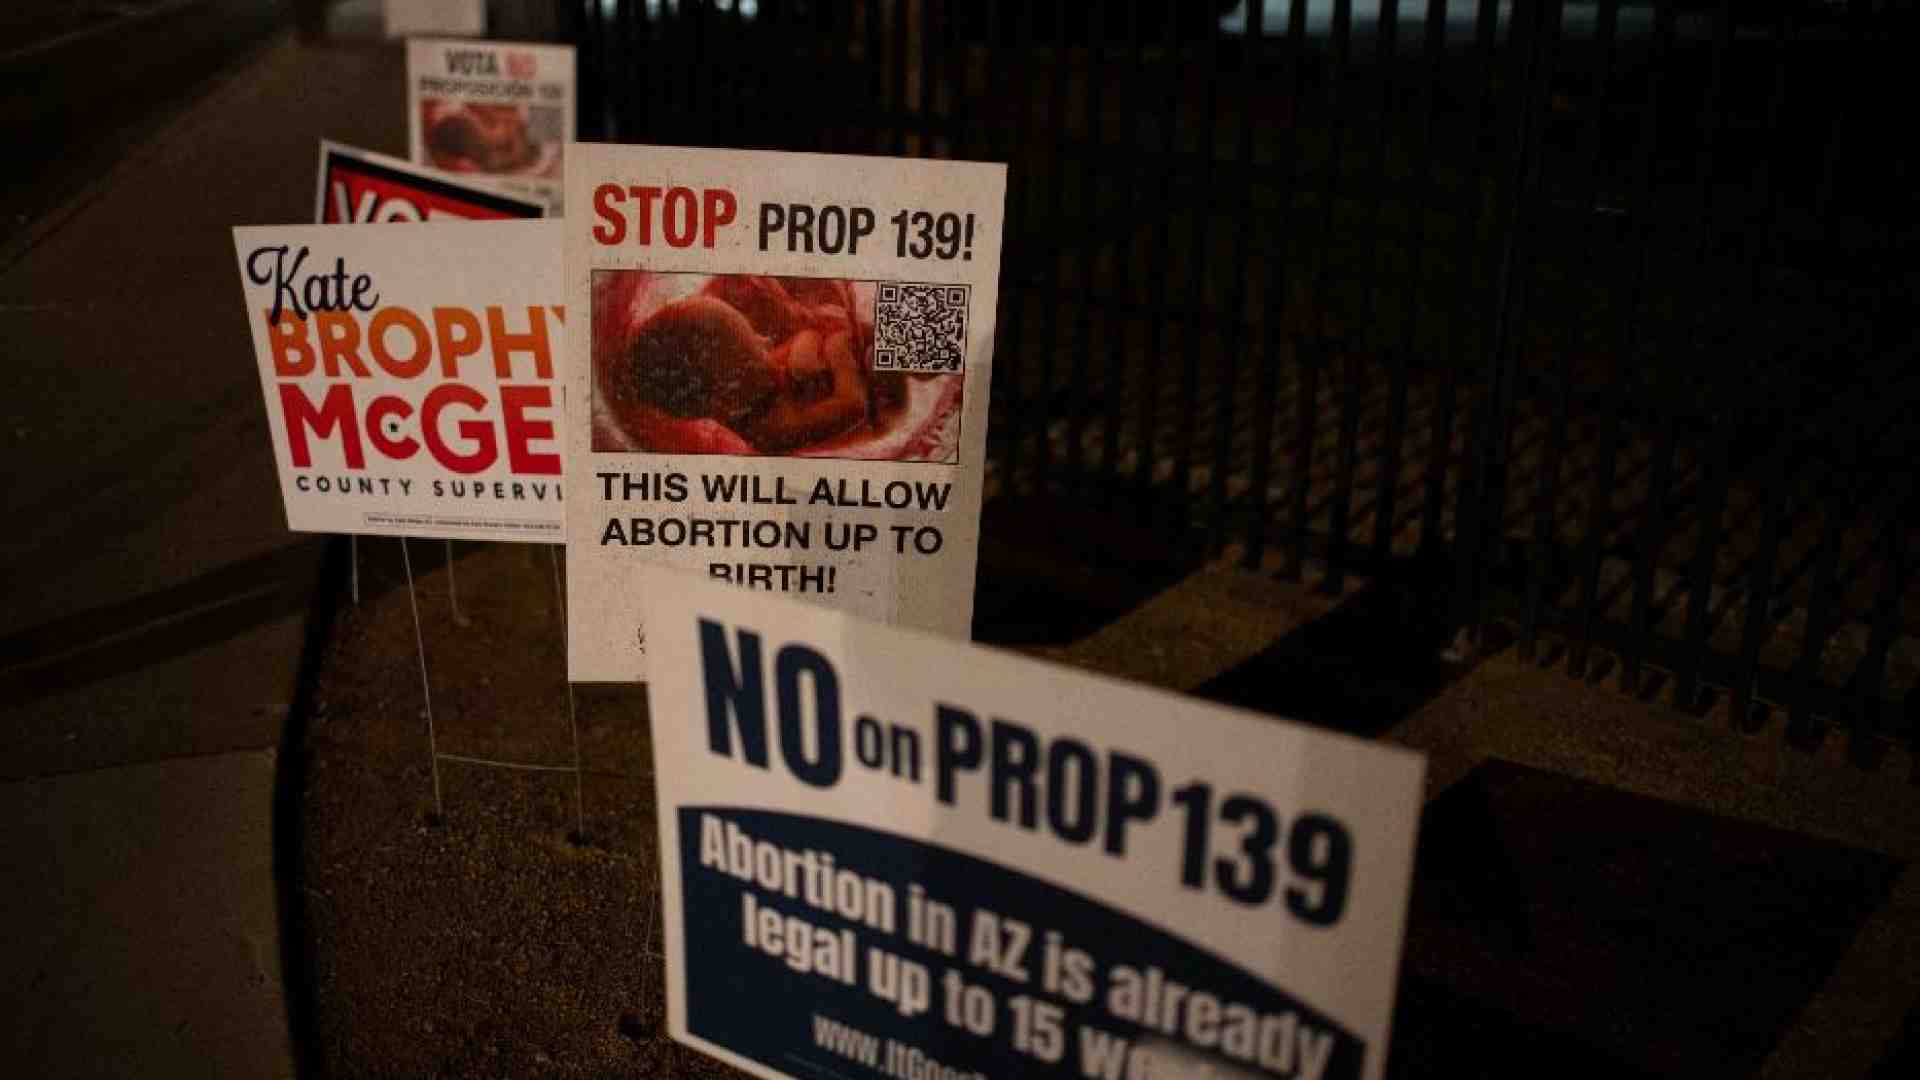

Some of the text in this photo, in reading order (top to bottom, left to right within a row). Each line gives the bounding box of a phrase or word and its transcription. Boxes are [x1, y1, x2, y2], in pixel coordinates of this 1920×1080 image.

[592, 183, 976, 262] STOP PROP 139!
[247, 245, 380, 327] Kate
[296, 476, 413, 497] COUNTY
[597, 472, 952, 511] THIS WILL ALLOW
[600, 518, 943, 555] ABORTION UP TO
[709, 563, 836, 593] BIRTH!
[697, 617, 1354, 928] NO on PROP 139
[699, 813, 1335, 1080] Abortion in AZ is already
[741, 892, 858, 987] legal
[868, 946, 931, 1018] up
[944, 968, 996, 1037] to
[1009, 996, 1066, 1064] 15
